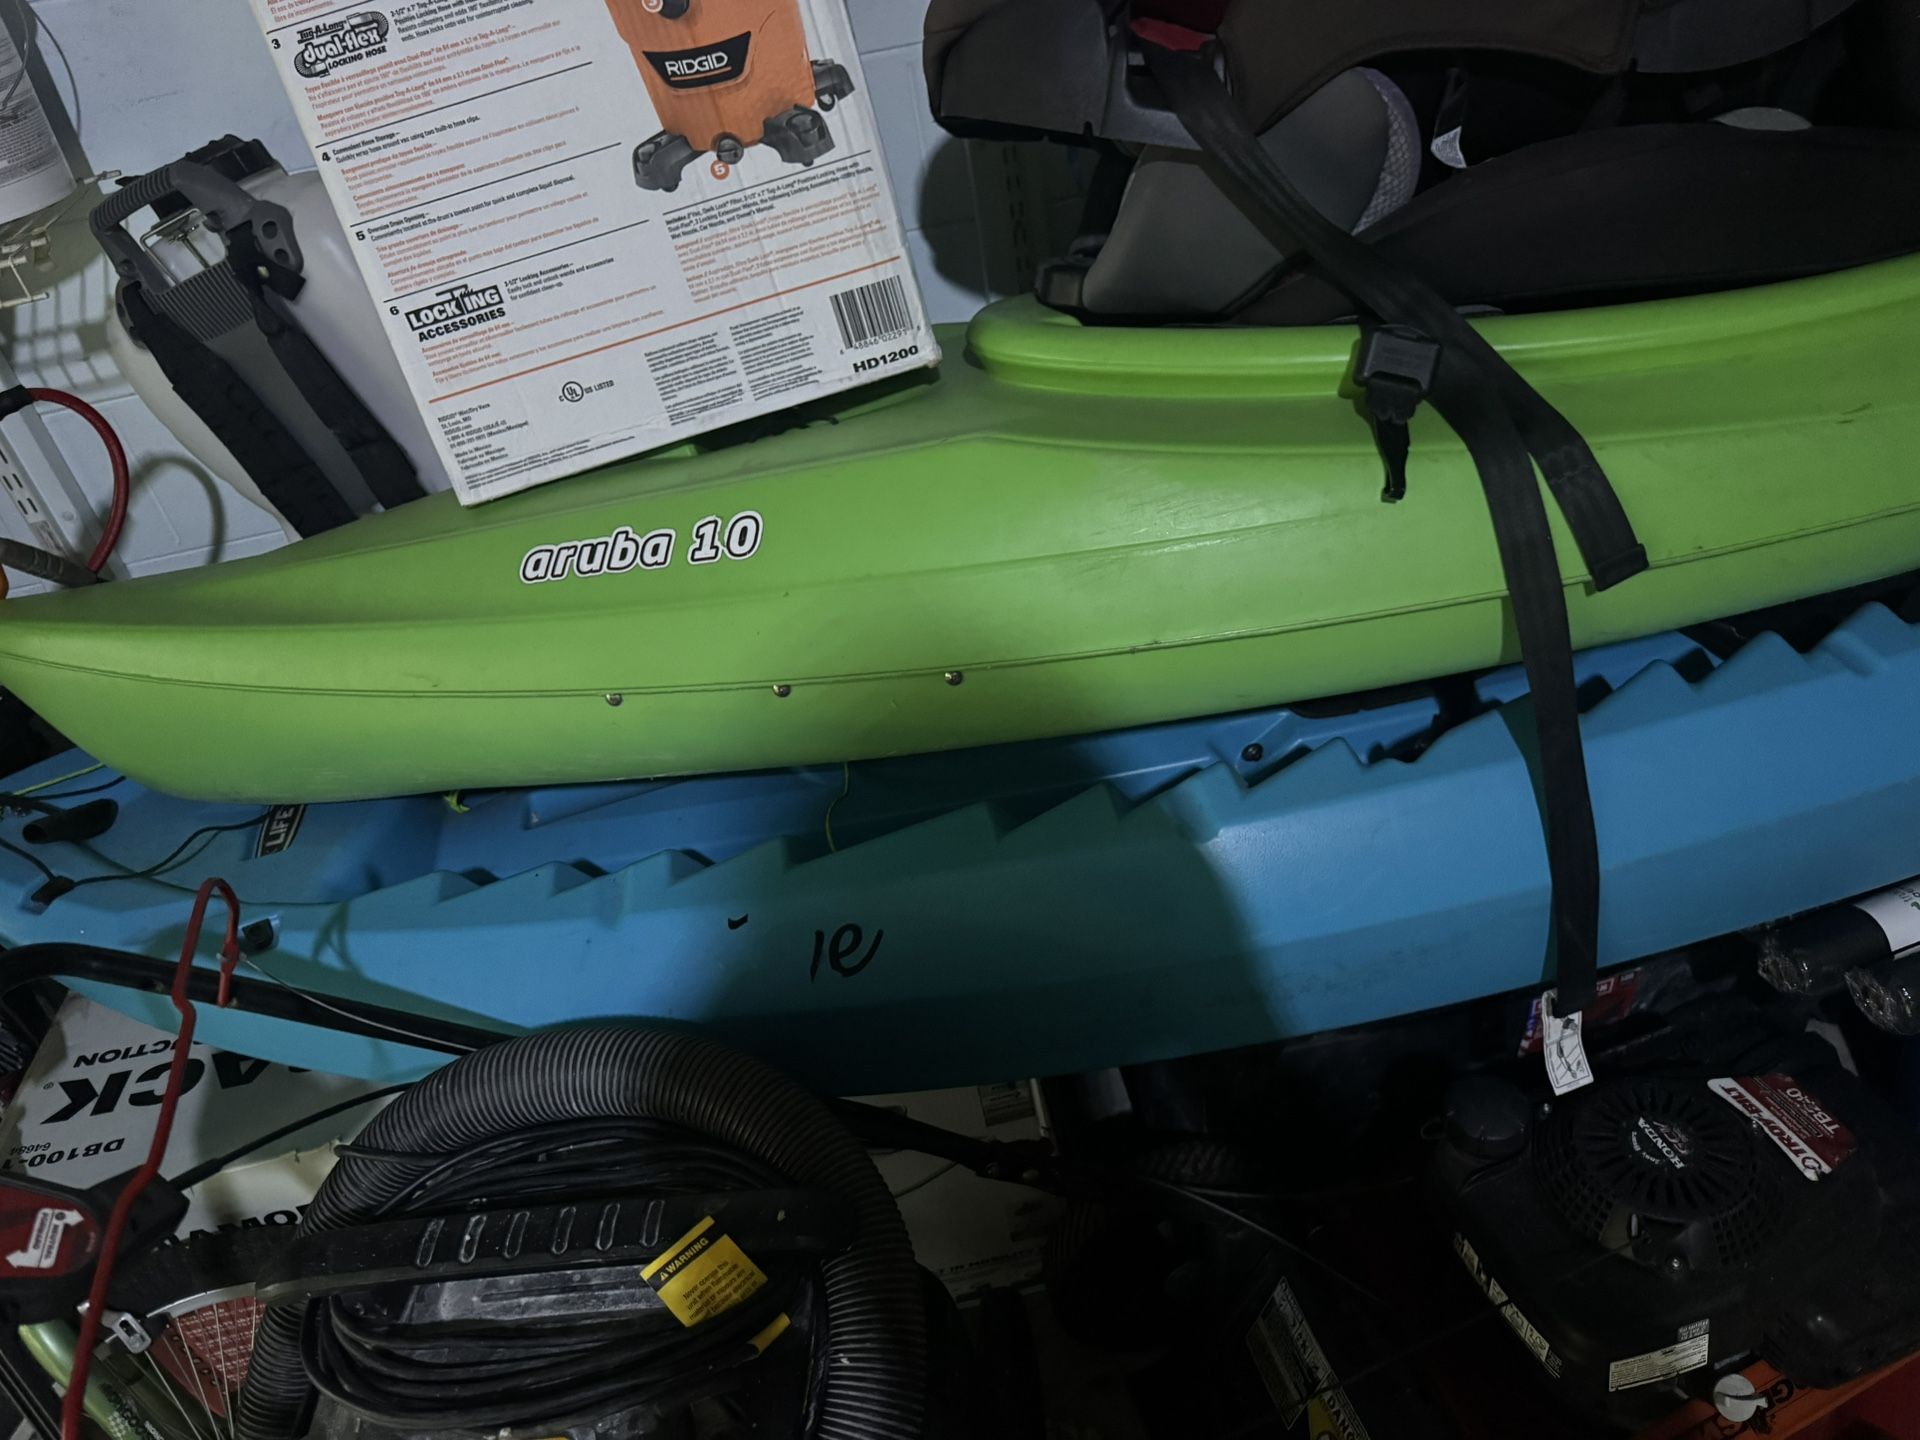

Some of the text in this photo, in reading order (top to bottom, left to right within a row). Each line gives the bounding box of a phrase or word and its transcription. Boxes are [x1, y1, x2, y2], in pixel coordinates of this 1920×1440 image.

[415, 7, 437, 19] Locking
[271, 39, 281, 50] 3
[300, 21, 383, 67] dual-flex
[328, 45, 387, 69] LOCKING HOSE
[664, 52, 728, 75] RIDGID
[320, 151, 331, 162] 4
[714, 164, 725, 176] 5
[355, 230, 366, 241] 5
[389, 305, 399, 315] 6
[417, 306, 506, 342] ACCESSORIES
[851, 344, 919, 373] HD1200
[584, 386, 593, 394] US
[593, 379, 614, 391] LISTED
[520, 510, 763, 584] aruba 10
[41, 1050, 312, 1126] ACK
[1720, 1083, 1806, 1157] TROY-BILT
[1631, 1116, 1689, 1170] HONDA
[665, 1238, 709, 1272] WARNING
